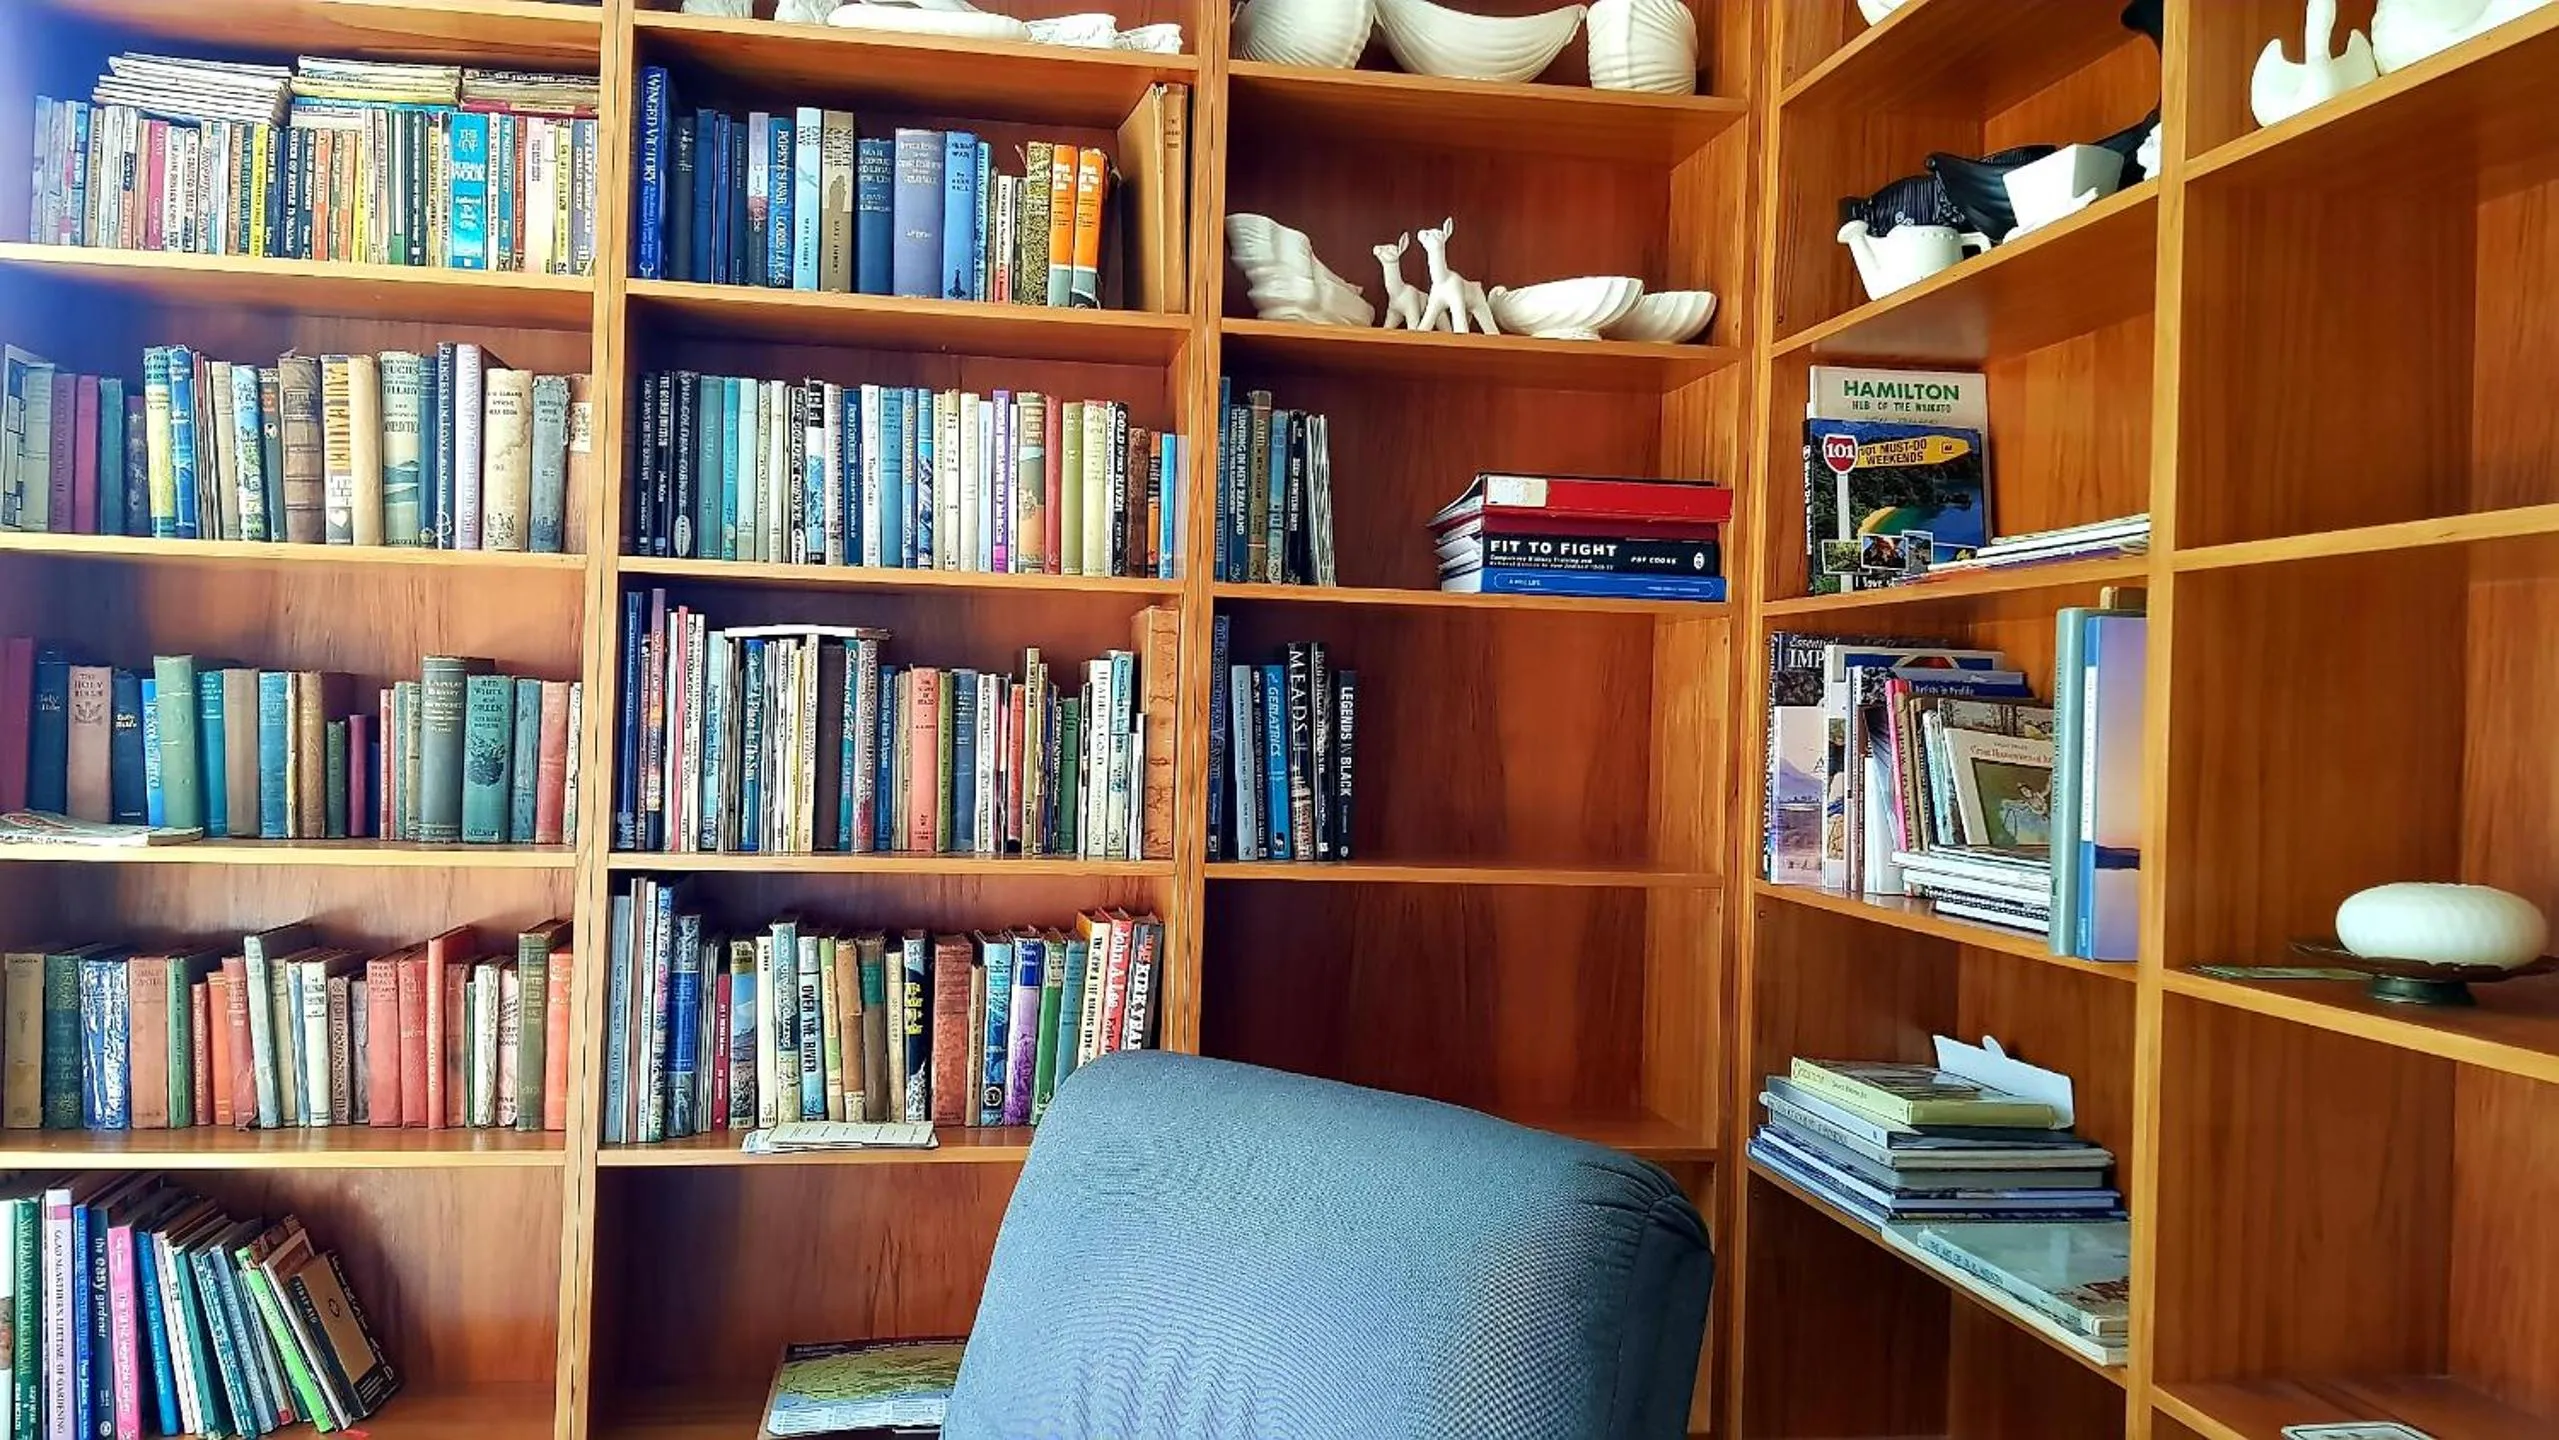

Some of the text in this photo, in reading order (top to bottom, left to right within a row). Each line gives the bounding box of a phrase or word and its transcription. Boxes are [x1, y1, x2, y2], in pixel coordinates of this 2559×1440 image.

[646, 73, 660, 127] WINGED
[643, 129, 660, 185] VICTORY
[824, 127, 833, 166] NIGHT
[842, 128, 852, 169] NIGHT
[776, 182, 788, 204] WAR
[198, 210, 209, 240] ZONE
[384, 366, 419, 375] FUCHS
[440, 347, 450, 400] PRINCESS
[1844, 380, 1958, 400] HAMILTON
[440, 404, 449, 418] IN
[1878, 402, 1886, 410] OF
[1894, 402, 1910, 412] THE
[1116, 410, 1126, 443] GOLD
[1237, 454, 1246, 464] IN
[1826, 442, 1856, 458] 101
[1866, 452, 1924, 464] WEEKENDS
[1880, 440, 1927, 454] MUST-DO
[1236, 466, 1246, 487] NEW
[1114, 473, 1124, 512] RIVER
[1236, 489, 1246, 535] ZEALAND
[1490, 540, 1618, 556] FIT TO FIGHT
[1862, 576, 1882, 588] love
[74, 681, 103, 690] HOLY
[74, 690, 103, 698] BIBLE
[844, 690, 852, 702] on
[882, 674, 891, 709] Shooting
[1289, 650, 1308, 732] MEADS
[473, 704, 502, 712] GREEN
[748, 703, 760, 728] Place
[882, 711, 890, 721] for
[882, 722, 890, 735] the
[1268, 687, 1281, 757] GERIATRICS
[747, 744, 758, 762] The
[1096, 734, 1106, 765] GOLD
[1340, 686, 1354, 797] LEGENDS IN BLACK
[746, 763, 757, 780] Sun
[1112, 927, 1130, 962] John
[1108, 985, 1124, 1008] Lee
[1132, 964, 1150, 1008] KIRK
[802, 985, 816, 1072] OVER THE RIVER
[20, 1218, 31, 1376] NEW ZEALAND PLANT CARE MANUAL
[92, 1238, 108, 1337] the easy gardener
[56, 1318, 64, 1360] LIFETIME
[56, 1364, 64, 1376] OF
[56, 1378, 65, 1434] GARDENING
